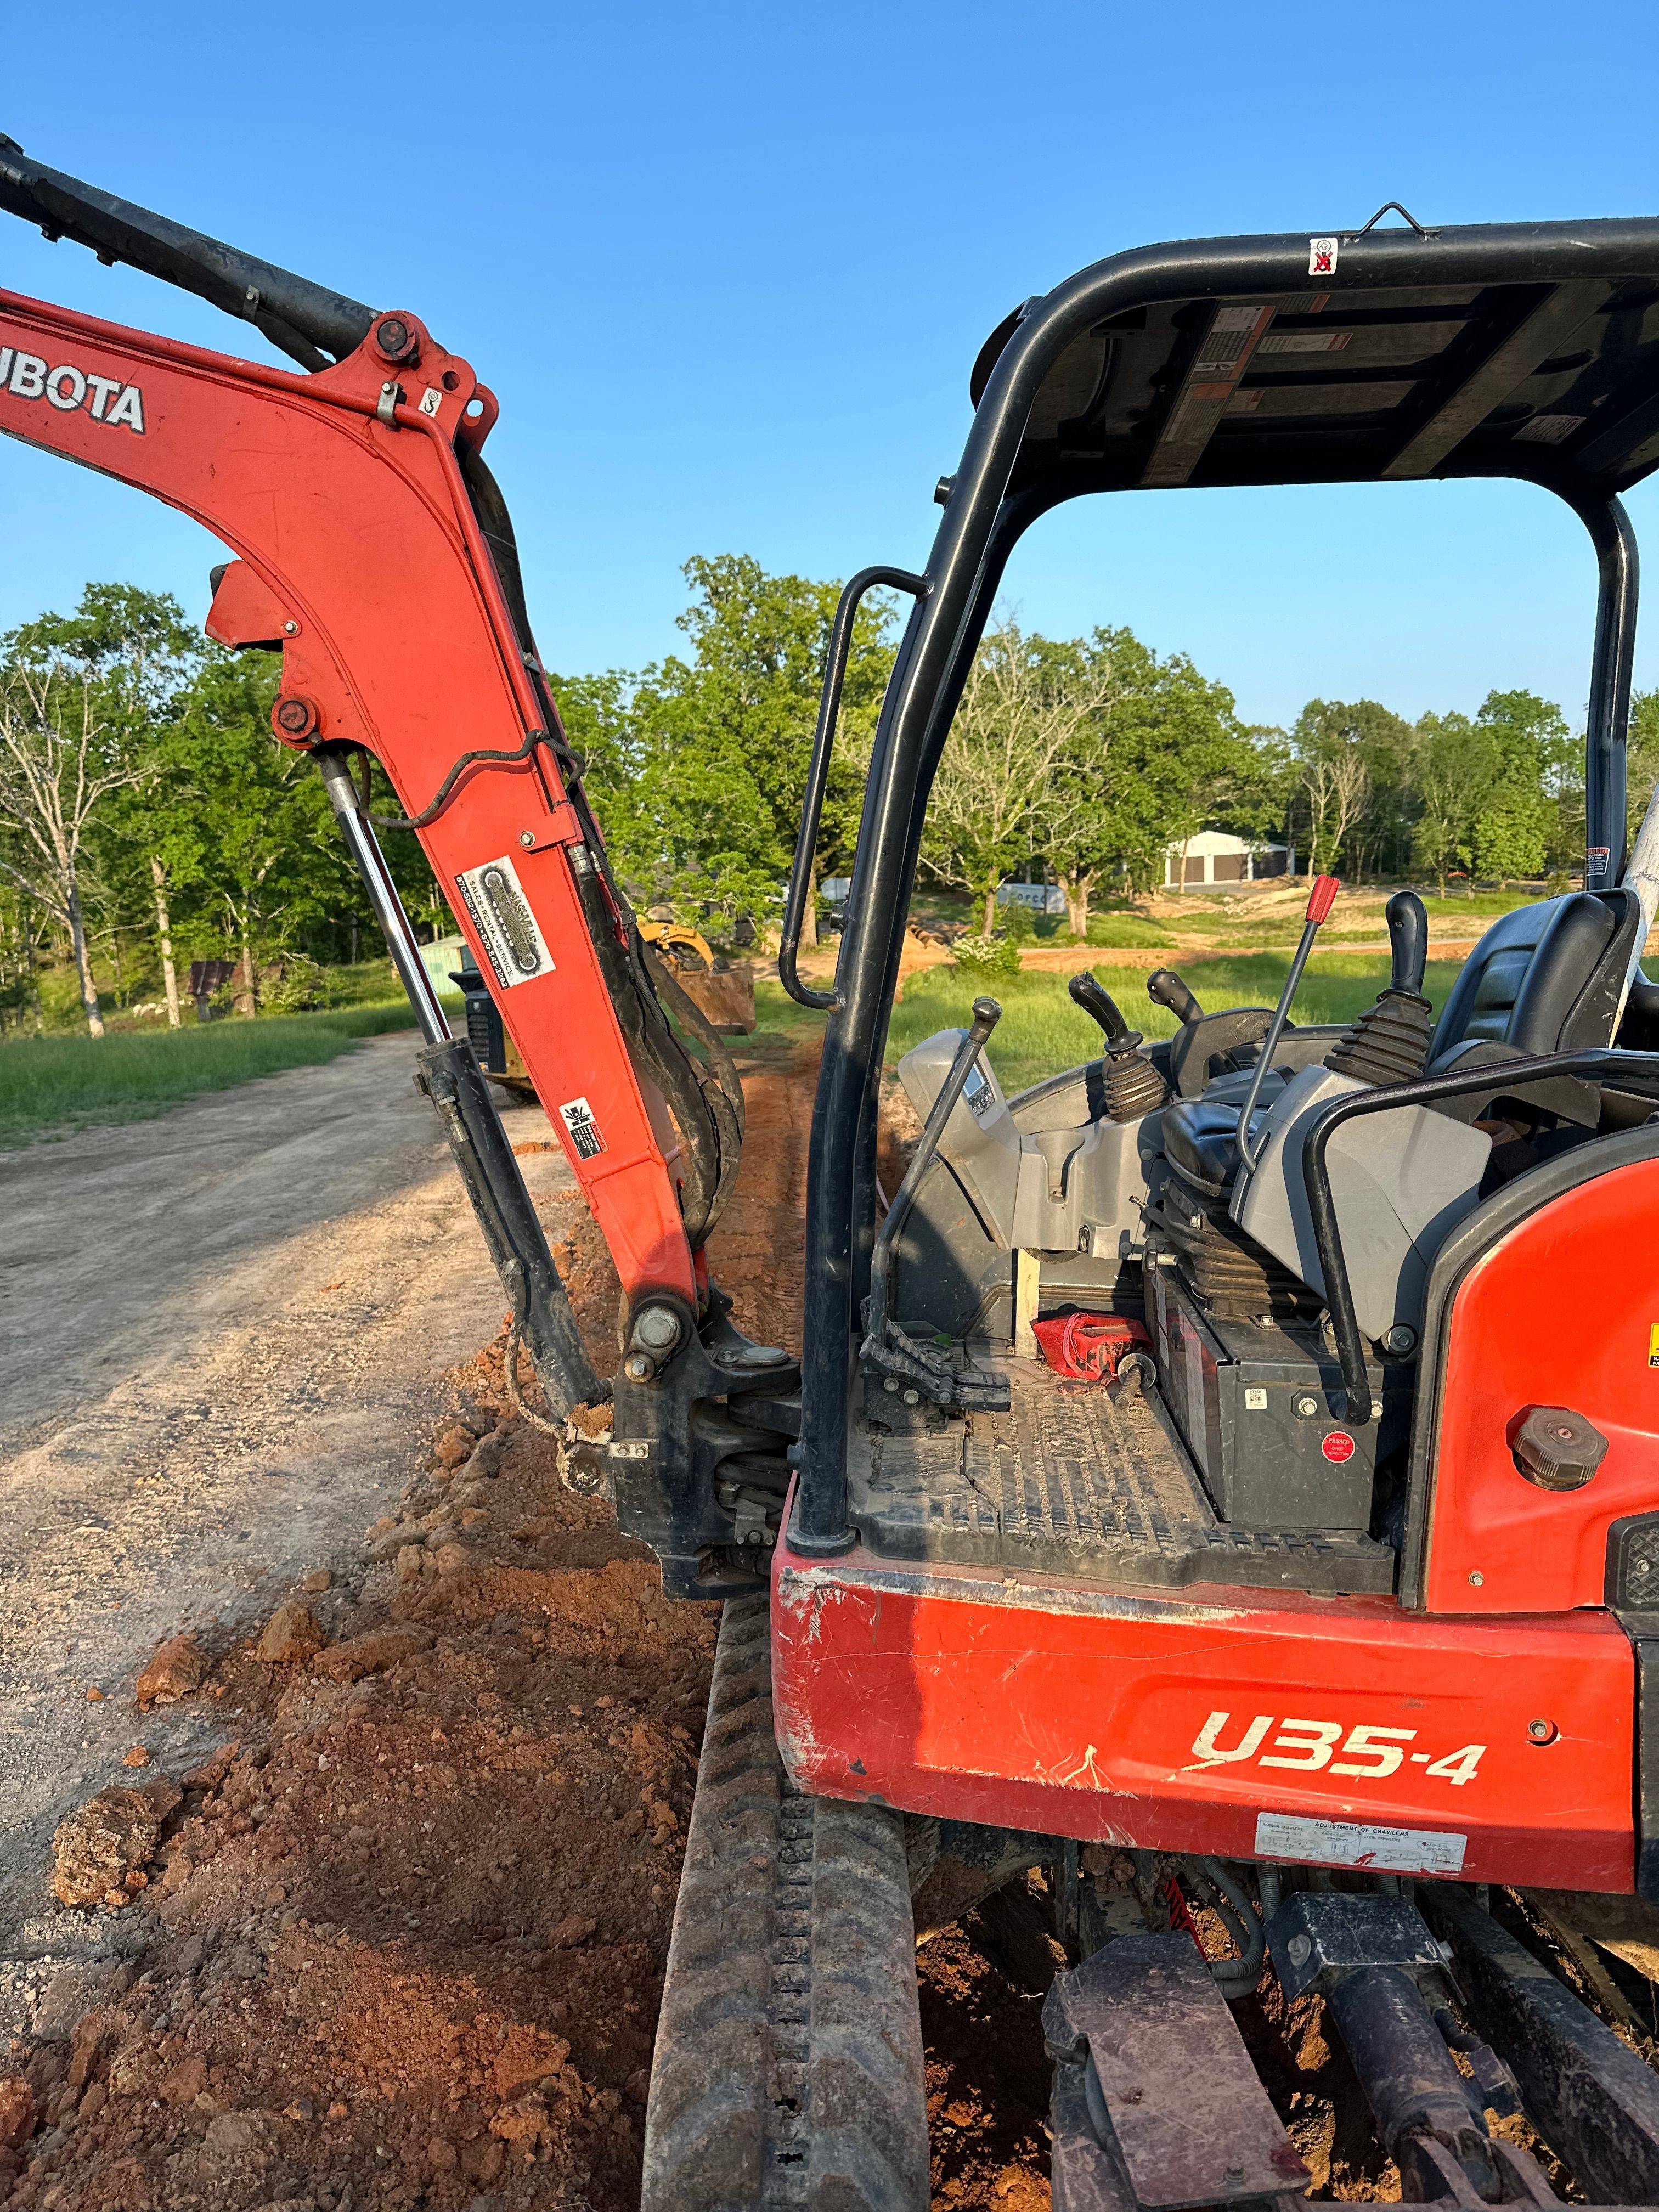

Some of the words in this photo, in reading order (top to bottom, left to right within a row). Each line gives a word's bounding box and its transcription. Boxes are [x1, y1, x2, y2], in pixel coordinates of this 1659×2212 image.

[456, 876, 482, 928] 870-582-1570
[481, 934, 508, 988] 870-845-2292
[470, 881, 483, 906] SALES
[482, 909, 498, 939] RENTAL
[496, 944, 514, 976] SERVICE
[489, 880, 517, 928] HOMETOWN
[510, 927, 534, 964] RENTALS
[509, 891, 537, 943] NASHVILLE
[1192, 1711, 1487, 1785] U35-4
[1315, 1822, 1358, 1831] ADJUSTMENT
[1373, 1829, 1409, 1837] CRAWLERS
